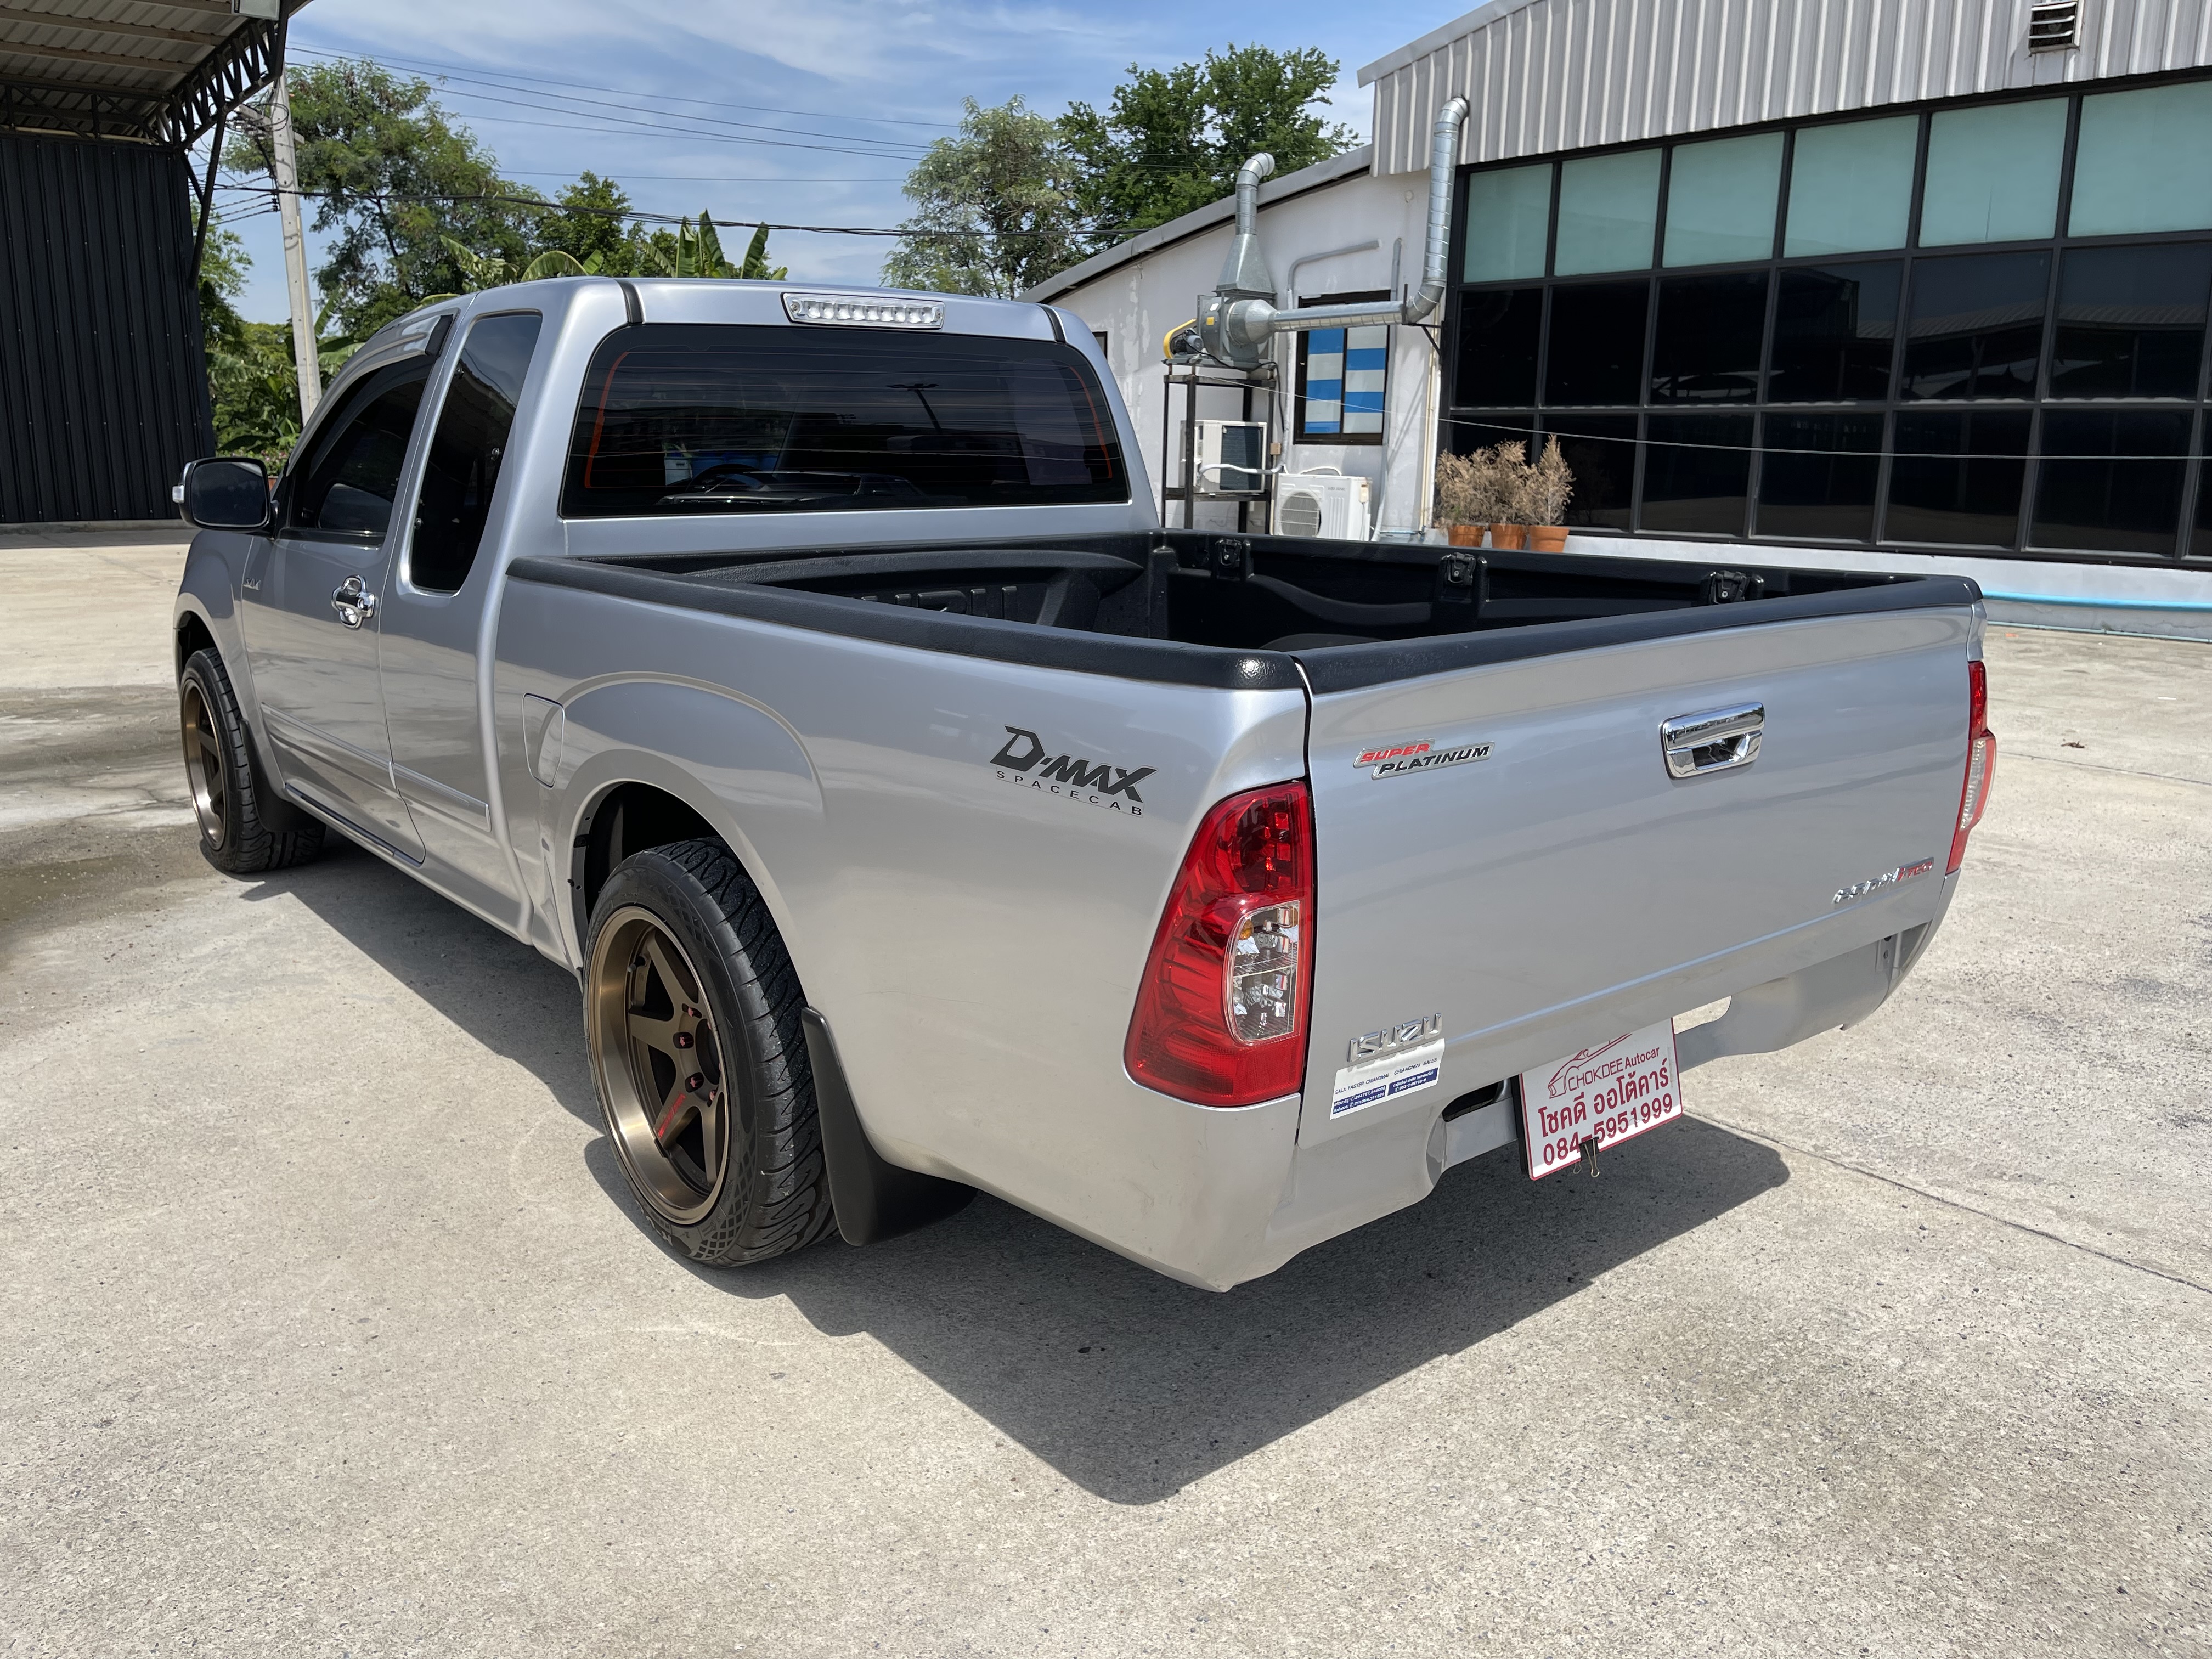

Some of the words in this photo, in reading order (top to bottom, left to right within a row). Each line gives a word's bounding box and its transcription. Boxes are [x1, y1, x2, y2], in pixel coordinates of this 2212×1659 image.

[990, 725, 1158, 803] D-MAX
[1360, 743, 1431, 763] SUPER
[1378, 746, 1490, 775] PLATINUM
[996, 770, 1142, 816] SPACECAB
[1347, 1012, 1443, 1062] ISUZU
[1335, 1087, 1346, 1095] SALA
[1347, 1081, 1364, 1091] FASTER
[1365, 1073, 1390, 1085] CHIANGMAI
[1393, 1063, 1421, 1075] CHIANGMAI
[1568, 1058, 1623, 1092] CHOKDEE
[1624, 1047, 1660, 1070] Autocar
[1538, 1091, 1587, 1137] โชคดี
[1594, 1057, 1669, 1115] ออโต้คาร์
[1543, 1093, 1673, 1166] 084-5951999
